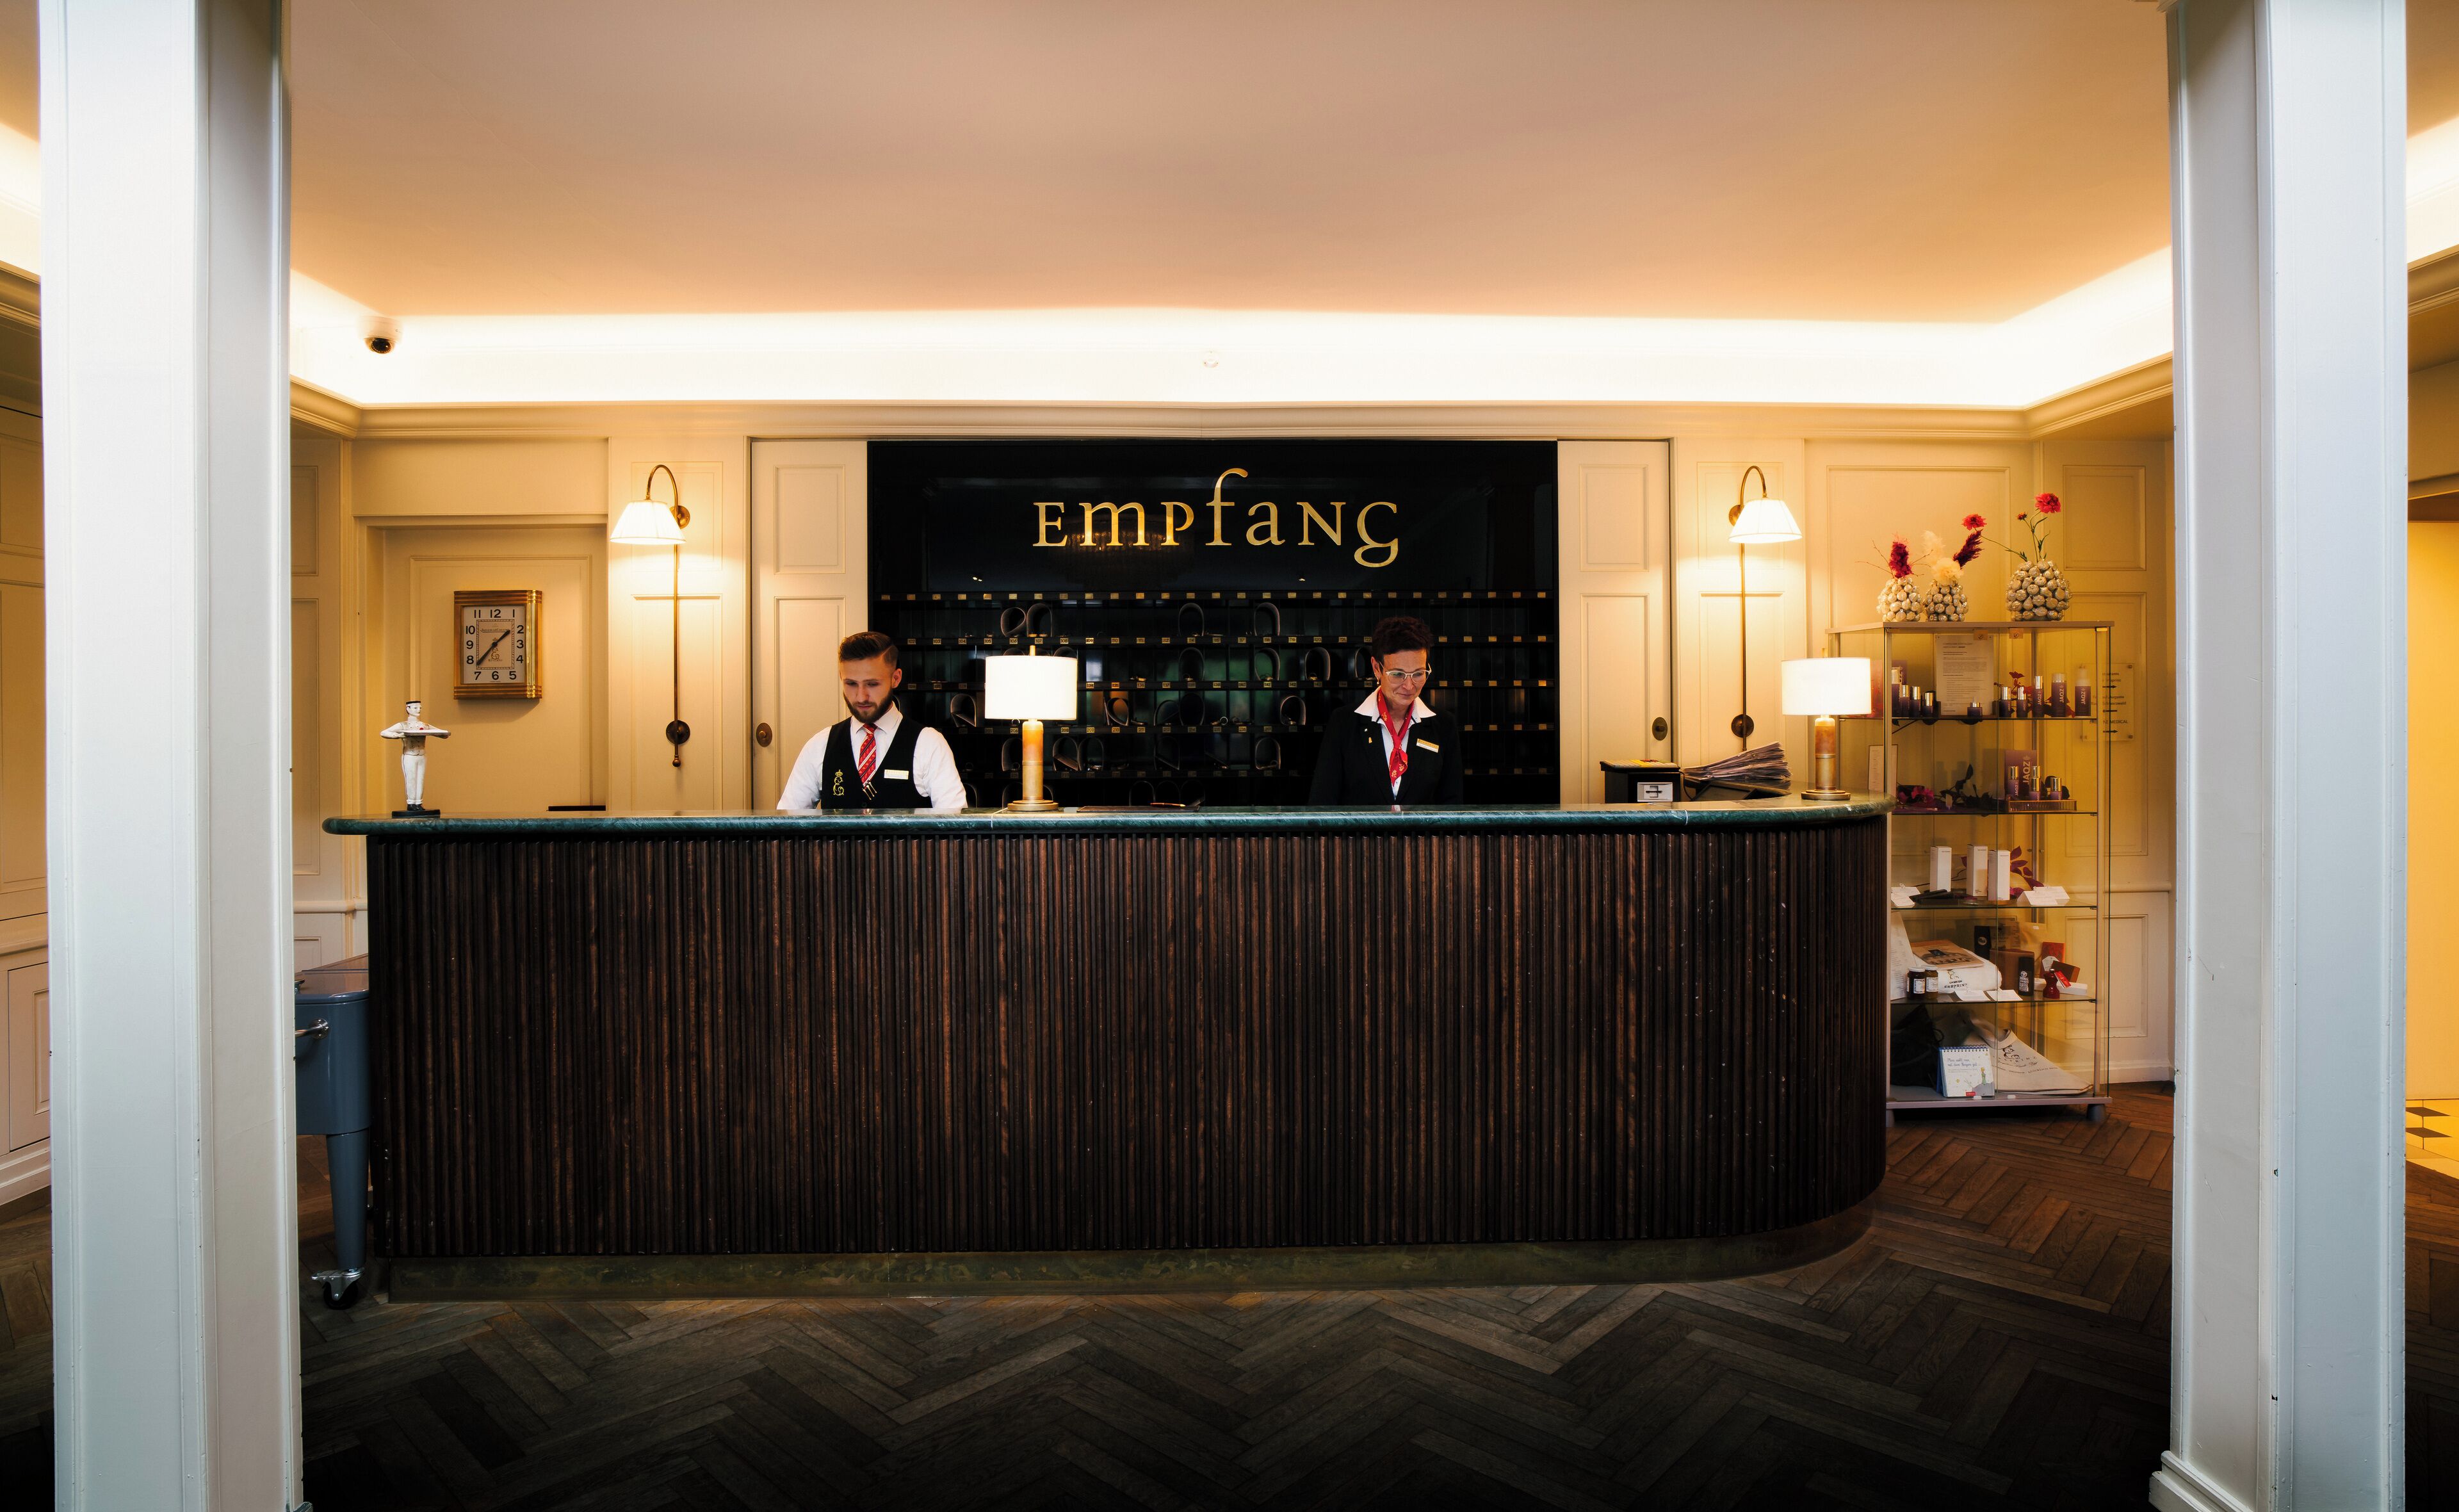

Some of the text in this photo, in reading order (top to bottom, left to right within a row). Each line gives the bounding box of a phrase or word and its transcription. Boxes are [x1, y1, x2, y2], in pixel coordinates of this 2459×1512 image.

[474, 609, 481, 618] 11
[490, 609, 501, 618] 12
[512, 609, 515, 618] 1
[466, 625, 475, 635] 10
[517, 625, 524, 634] 2
[466, 640, 473, 649] 9
[516, 640, 524, 649] 3
[467, 655, 474, 665] 8
[516, 655, 524, 663] 4
[474, 671, 482, 680] 7
[491, 671, 499, 680] 6
[509, 671, 517, 679] 5
